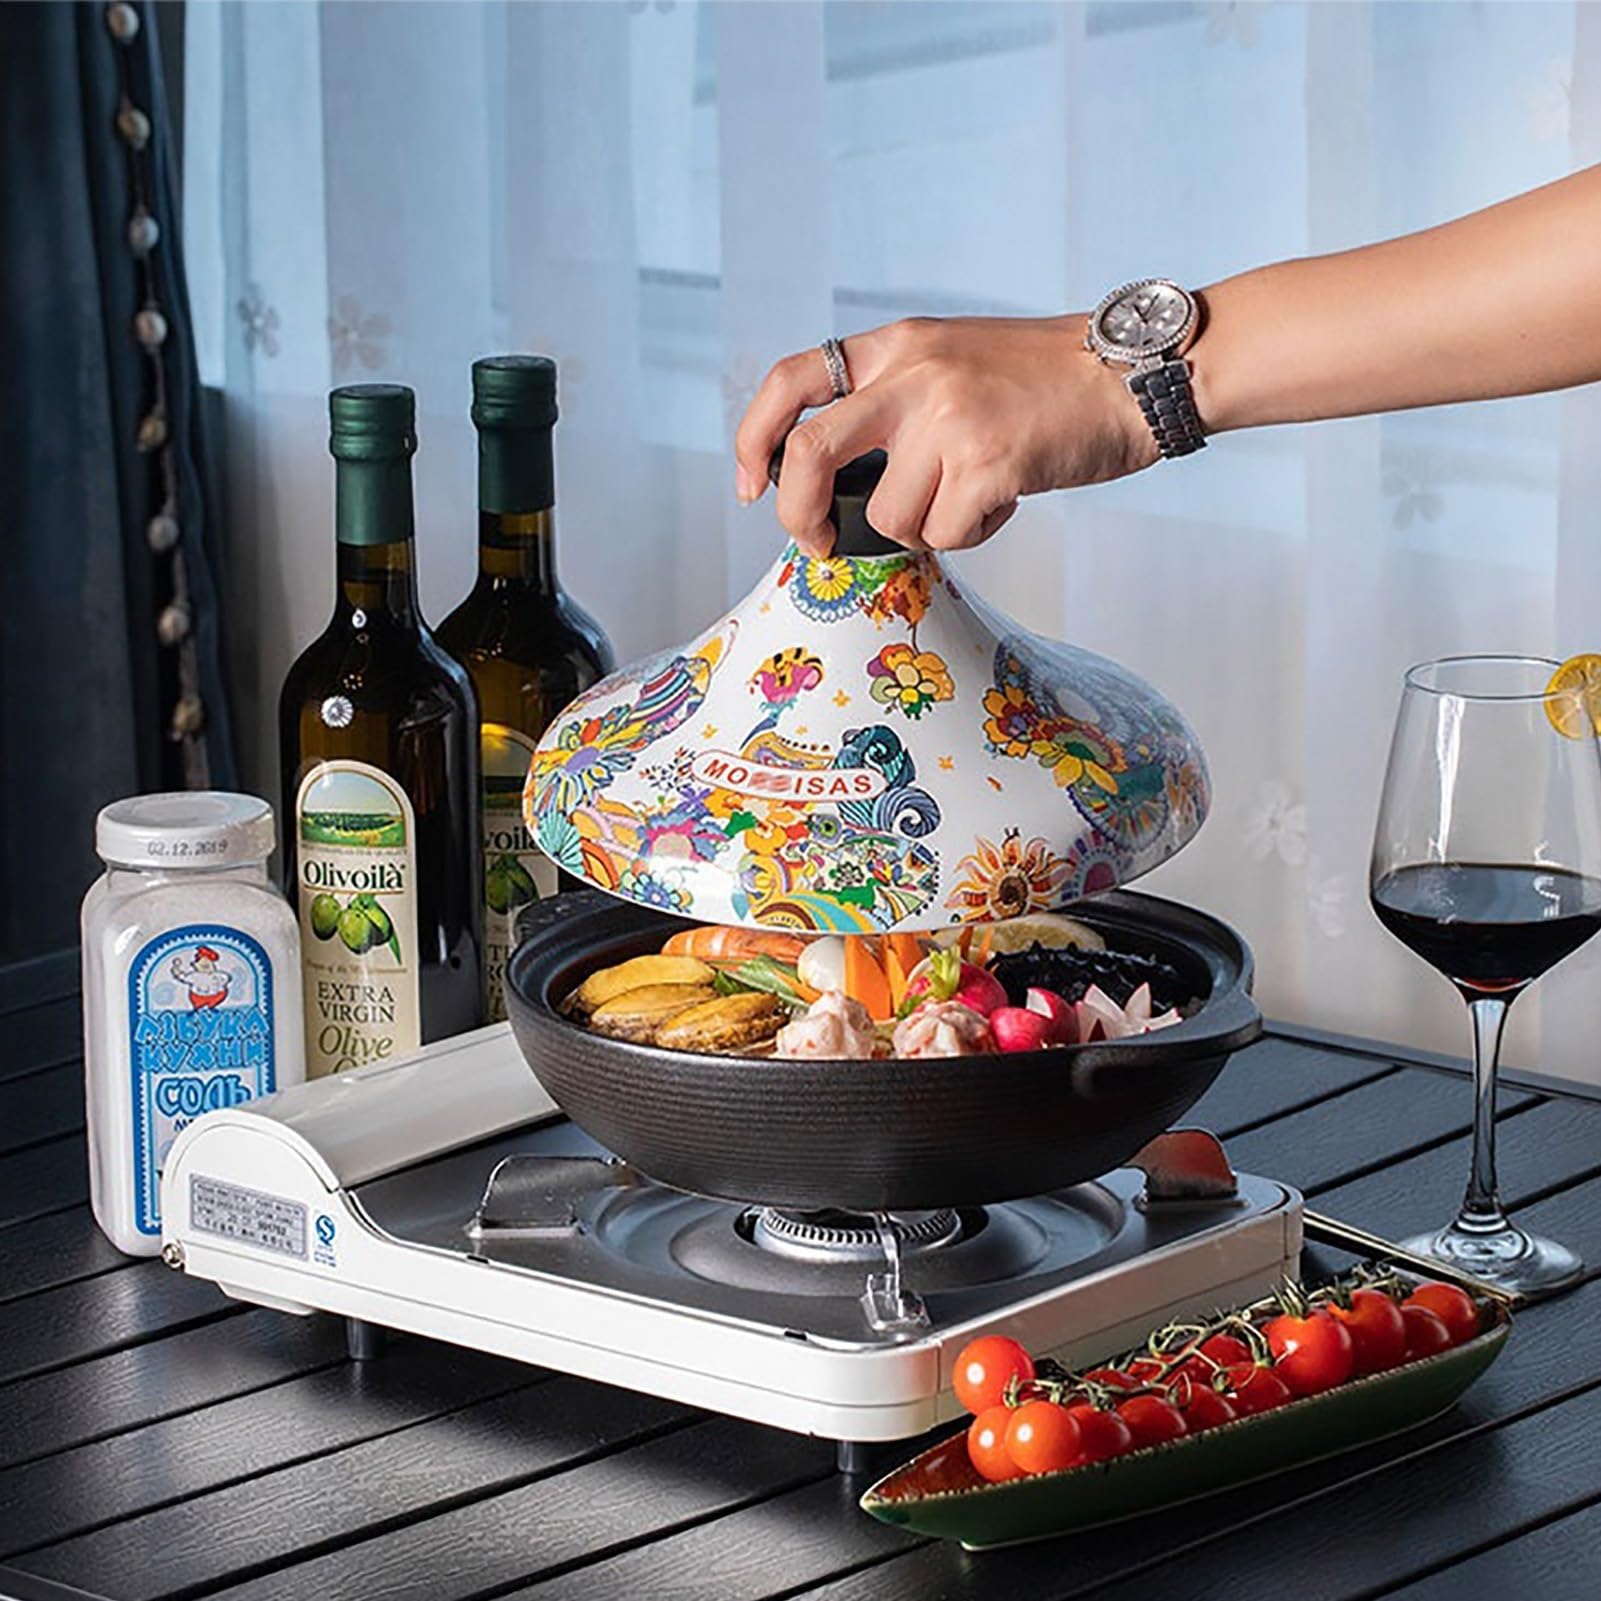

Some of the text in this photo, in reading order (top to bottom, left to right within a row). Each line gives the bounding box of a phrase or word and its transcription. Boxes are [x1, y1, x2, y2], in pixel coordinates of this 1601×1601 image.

[703, 758, 872, 795] MOISAS
[303, 860, 403, 889] Olivoilà
[318, 981, 394, 1002] EXTRA
[134, 1008, 270, 1045] АЗБУКА
[318, 1001, 394, 1023] VIRGIN
[140, 1038, 268, 1073] КУХНИ
[319, 1025, 393, 1058] Olive
[156, 1074, 252, 1117] СОЛЬ
